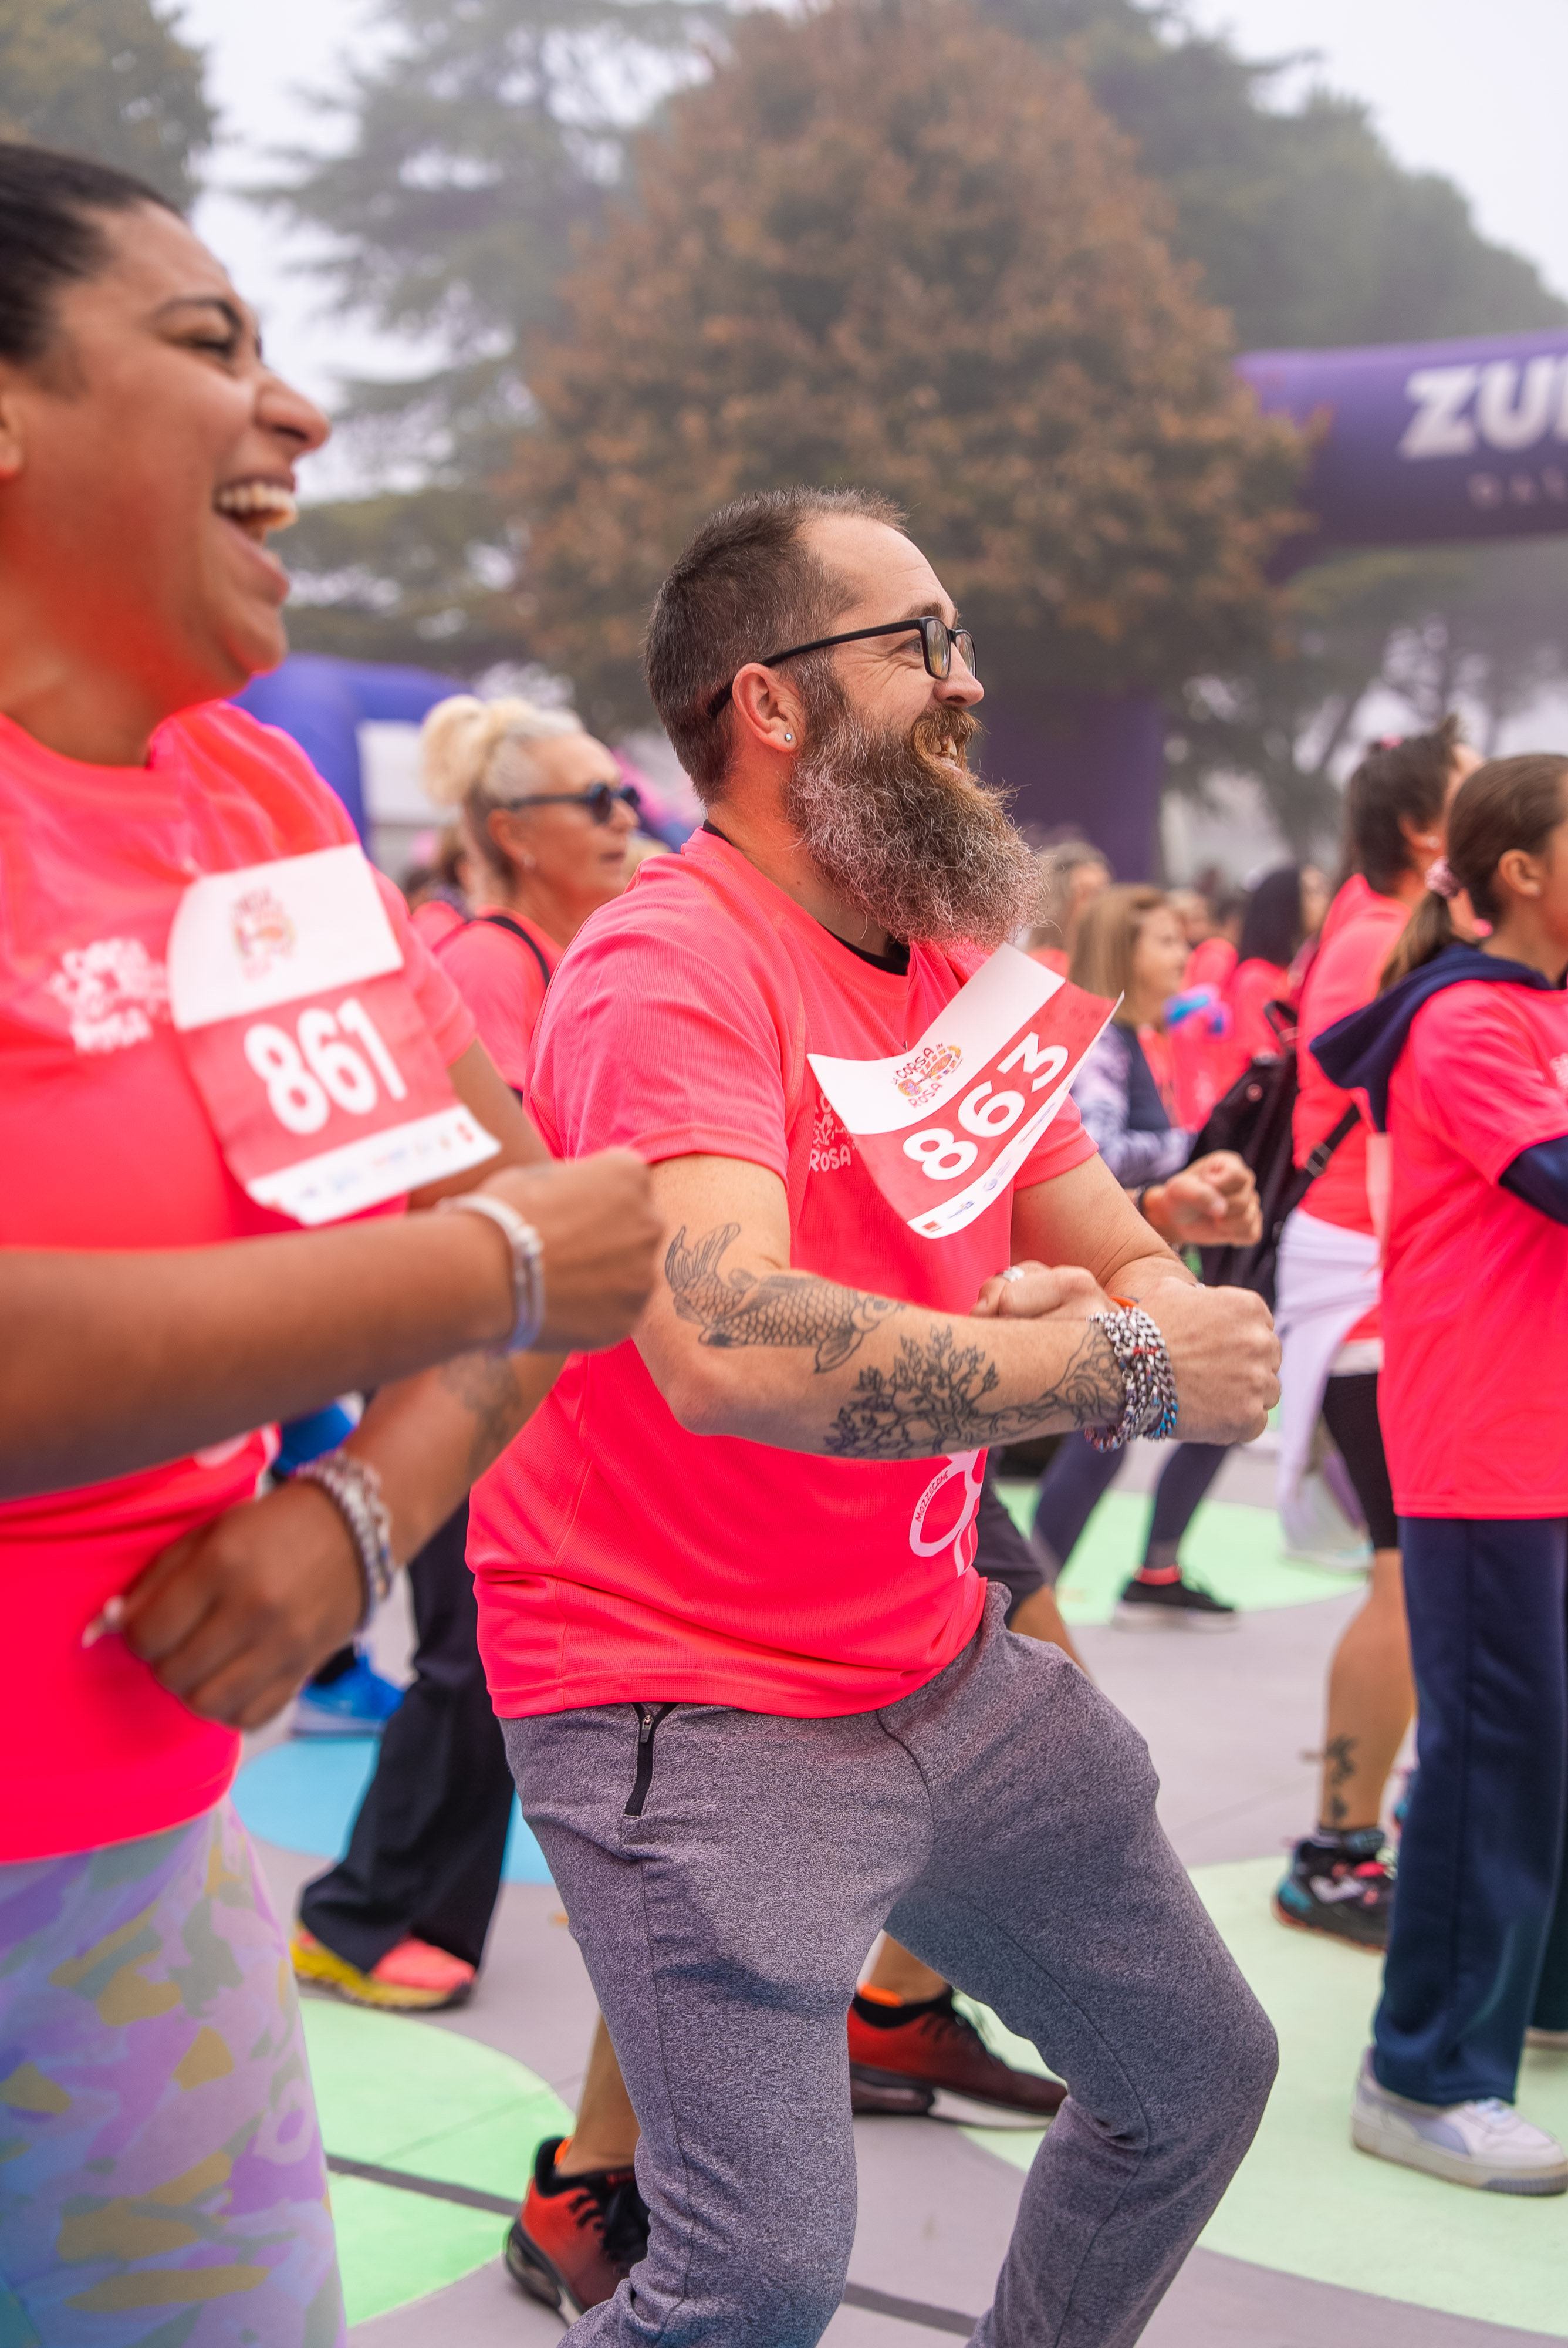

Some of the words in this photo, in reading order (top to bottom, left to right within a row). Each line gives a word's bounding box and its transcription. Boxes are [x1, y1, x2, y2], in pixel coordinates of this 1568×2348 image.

[1399, 354, 1568, 461] ZU
[244, 998, 407, 1136] 861
[895, 1048, 934, 1079] CORSA
[903, 1031, 1069, 1180] 863
[908, 1082, 944, 1108] ROSA
[808, 1143, 851, 1172] ROSA
[914, 1470, 949, 1523] MOZZECANE
